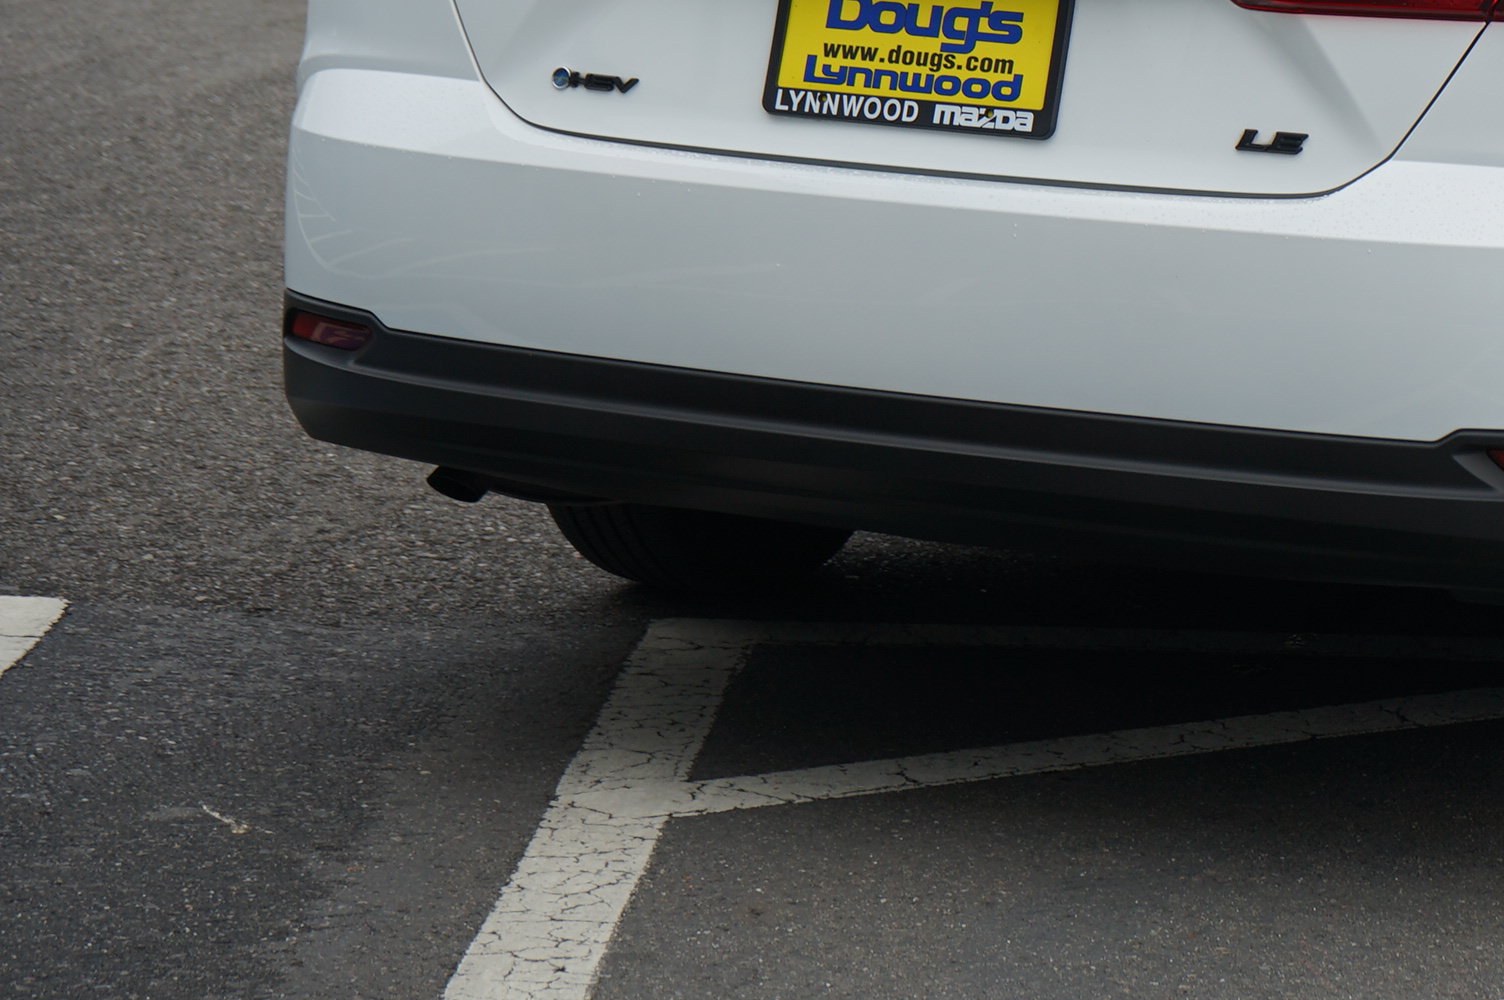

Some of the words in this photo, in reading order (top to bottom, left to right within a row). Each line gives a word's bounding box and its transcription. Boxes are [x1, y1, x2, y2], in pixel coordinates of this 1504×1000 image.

[823, 42, 1015, 75] www.dougs.com
[803, 54, 1024, 103] Lynnwood
[774, 88, 920, 123] LYNNWOOD
[1235, 129, 1309, 155] LE
